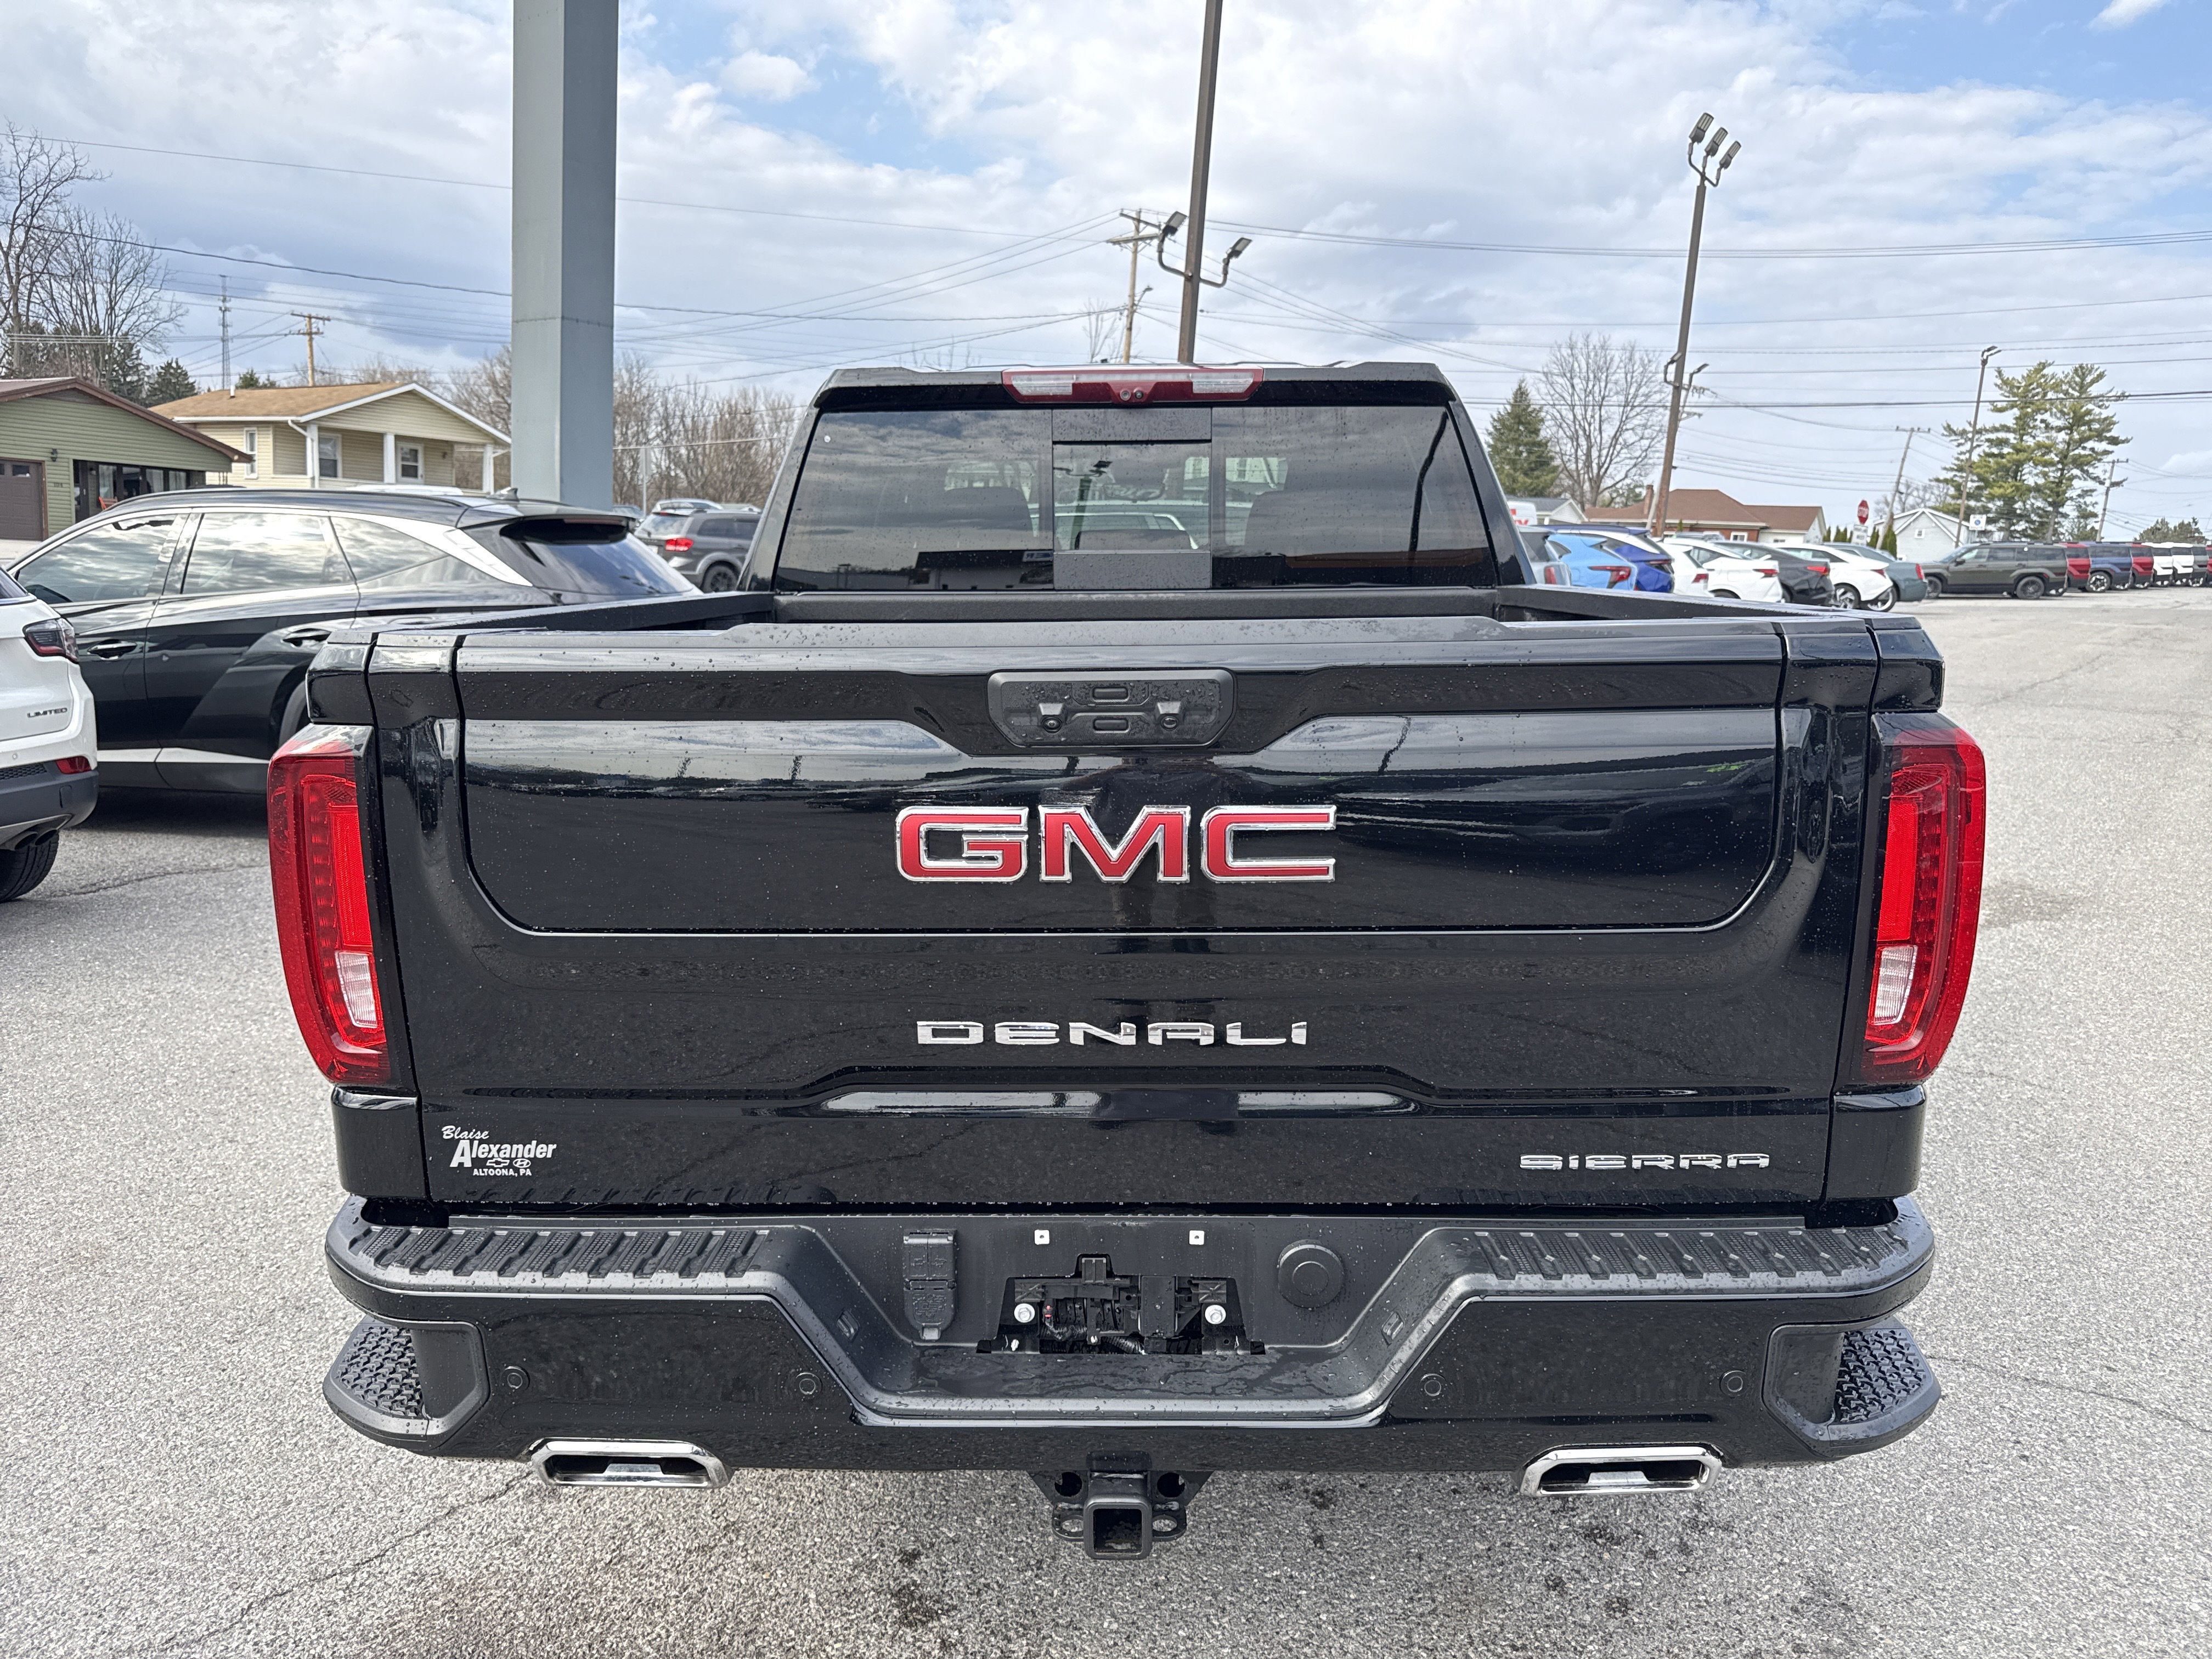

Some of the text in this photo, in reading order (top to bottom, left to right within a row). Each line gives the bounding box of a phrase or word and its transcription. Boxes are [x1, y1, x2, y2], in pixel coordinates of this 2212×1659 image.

[27, 708, 67, 718] LIMITED
[895, 805, 1337, 883] GMC
[917, 1021, 1307, 1045] DENALI
[441, 1125, 489, 1139] Blaise
[449, 1139, 557, 1167] Alexander
[1520, 1153, 1770, 1170] SIERRA
[472, 1169, 518, 1177] ALTOONA,
